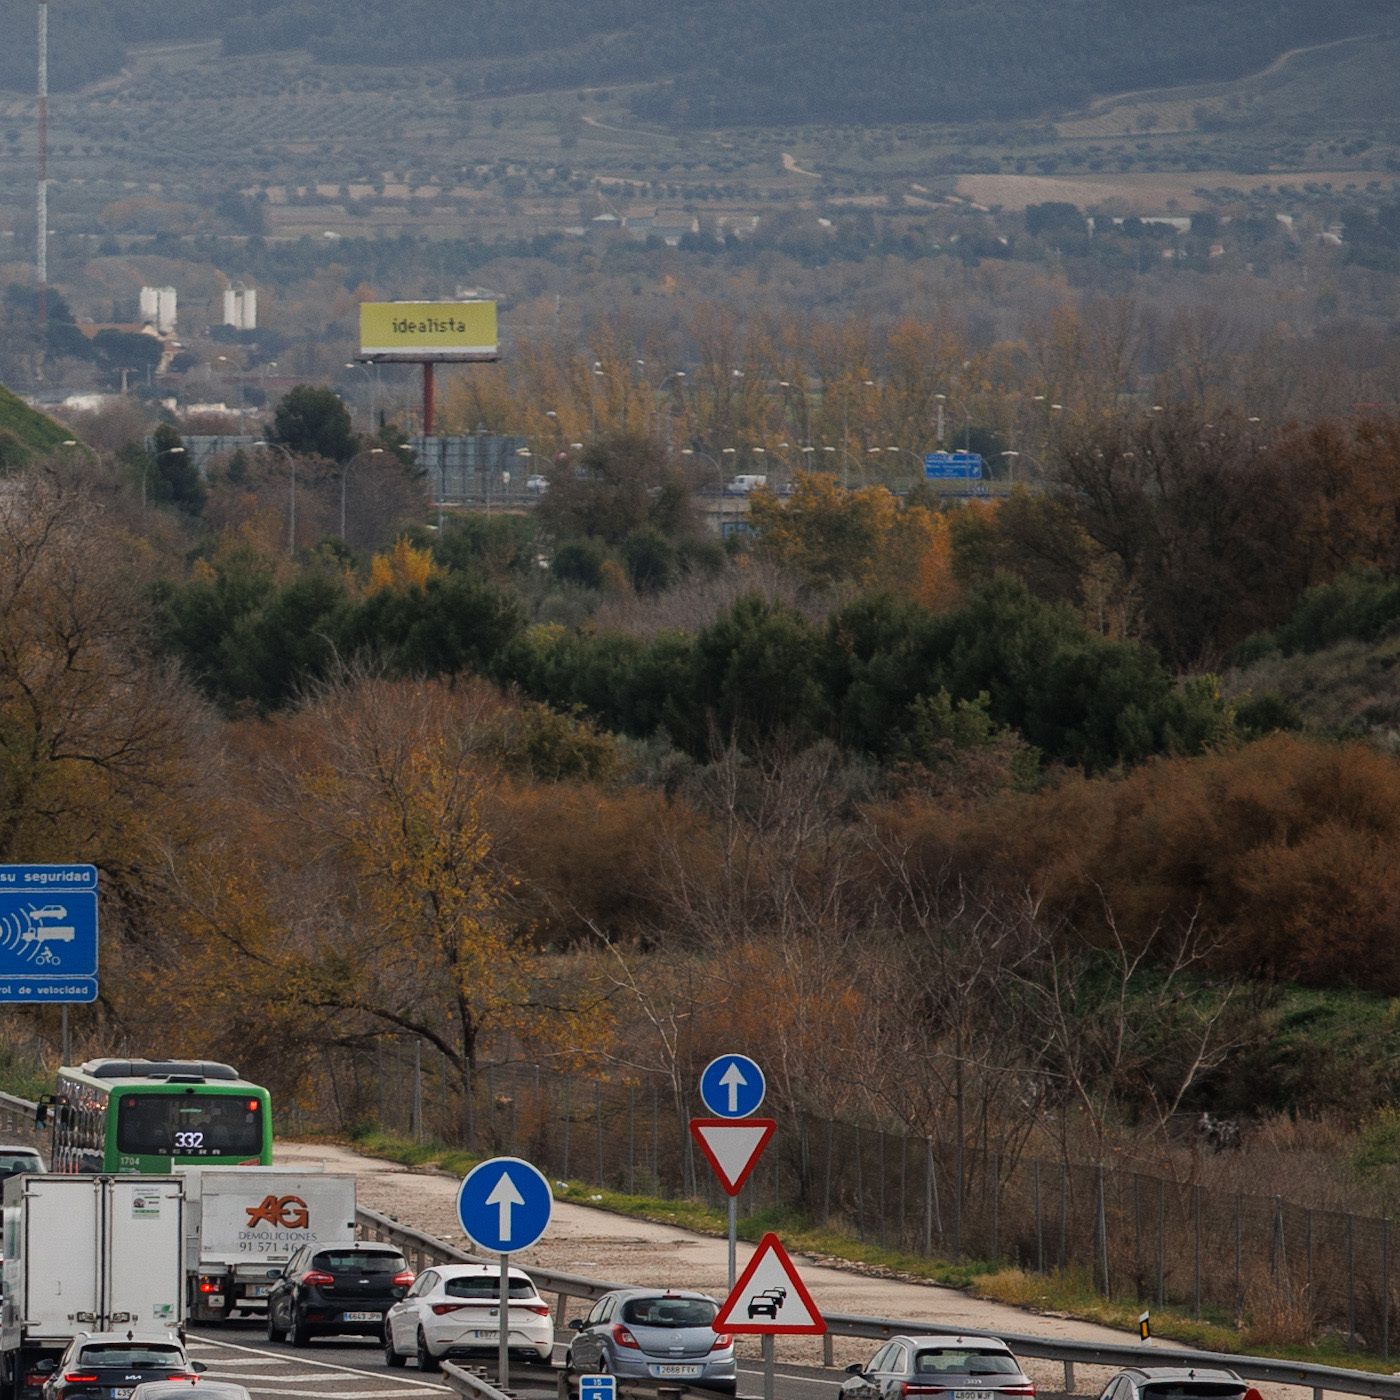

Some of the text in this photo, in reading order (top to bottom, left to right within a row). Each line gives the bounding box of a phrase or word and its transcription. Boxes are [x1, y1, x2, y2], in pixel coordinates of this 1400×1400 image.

[391, 317, 467, 333] idealista
[0, 872, 16, 882] su
[23, 870, 91, 884] seguridad
[18, 985, 32, 994] de
[36, 984, 89, 995] velocidad
[175, 1132, 204, 1148] 332
[120, 1157, 140, 1166] 1704
[246, 1194, 310, 1229] AG
[238, 1231, 318, 1241] DEMOLICIONES
[239, 1241, 253, 1252] 91
[257, 1242, 278, 1252] 571
